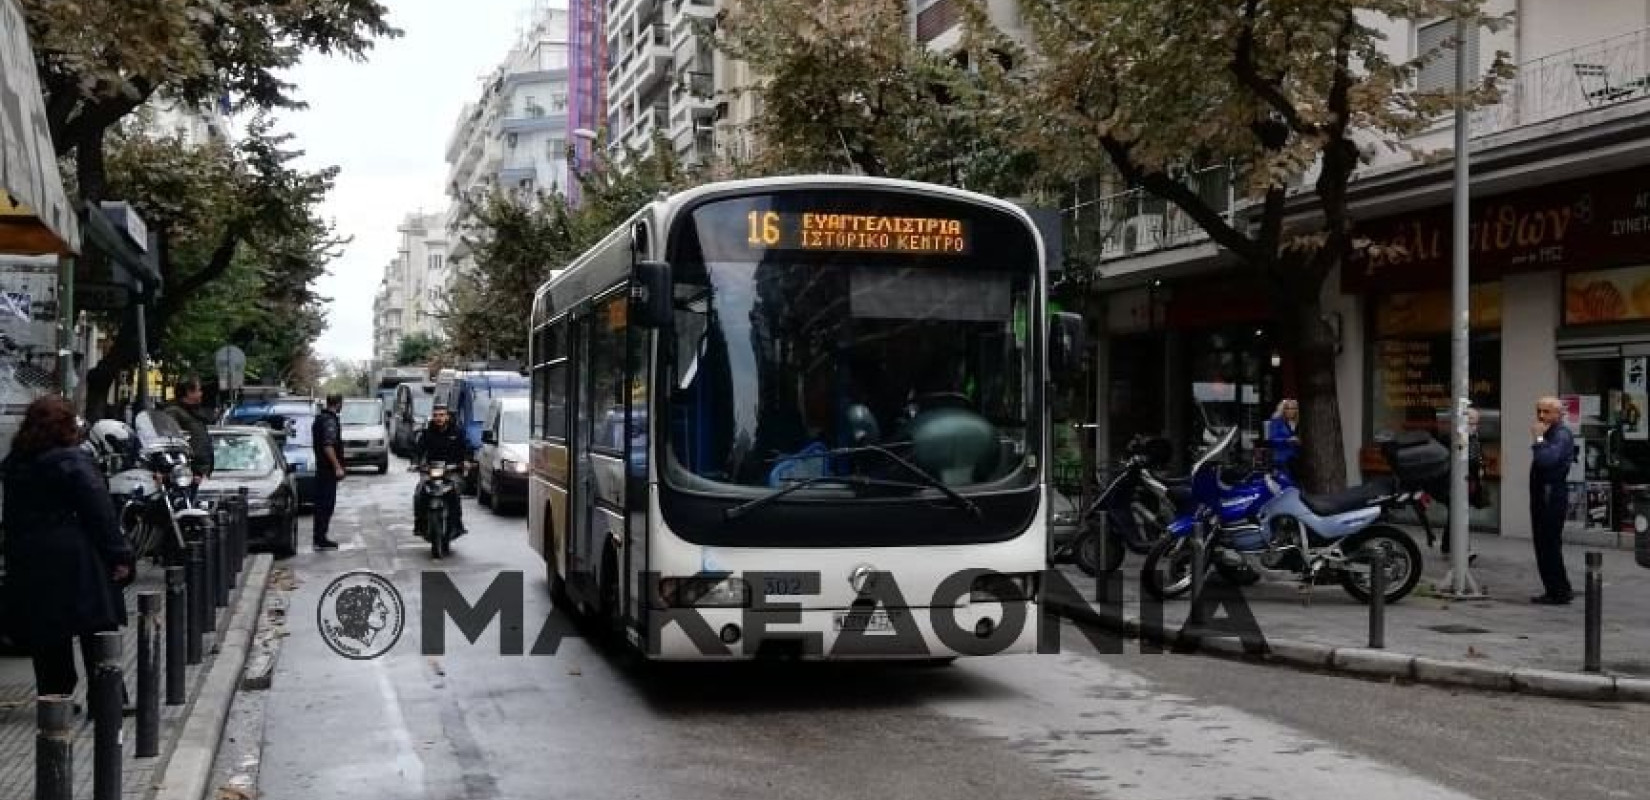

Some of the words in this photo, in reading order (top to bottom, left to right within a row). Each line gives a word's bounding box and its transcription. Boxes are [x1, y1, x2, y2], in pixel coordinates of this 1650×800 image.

[748, 210, 780, 245] 16
[802, 212, 962, 235] ΕΥΑΓΓΕΛΙΣΤΡΙΑ
[801, 230, 889, 249] ΙΣΤΟΡΙΚΟ
[898, 235, 964, 252] ΚΕΝΤΡΟ
[763, 577, 801, 595] 302
